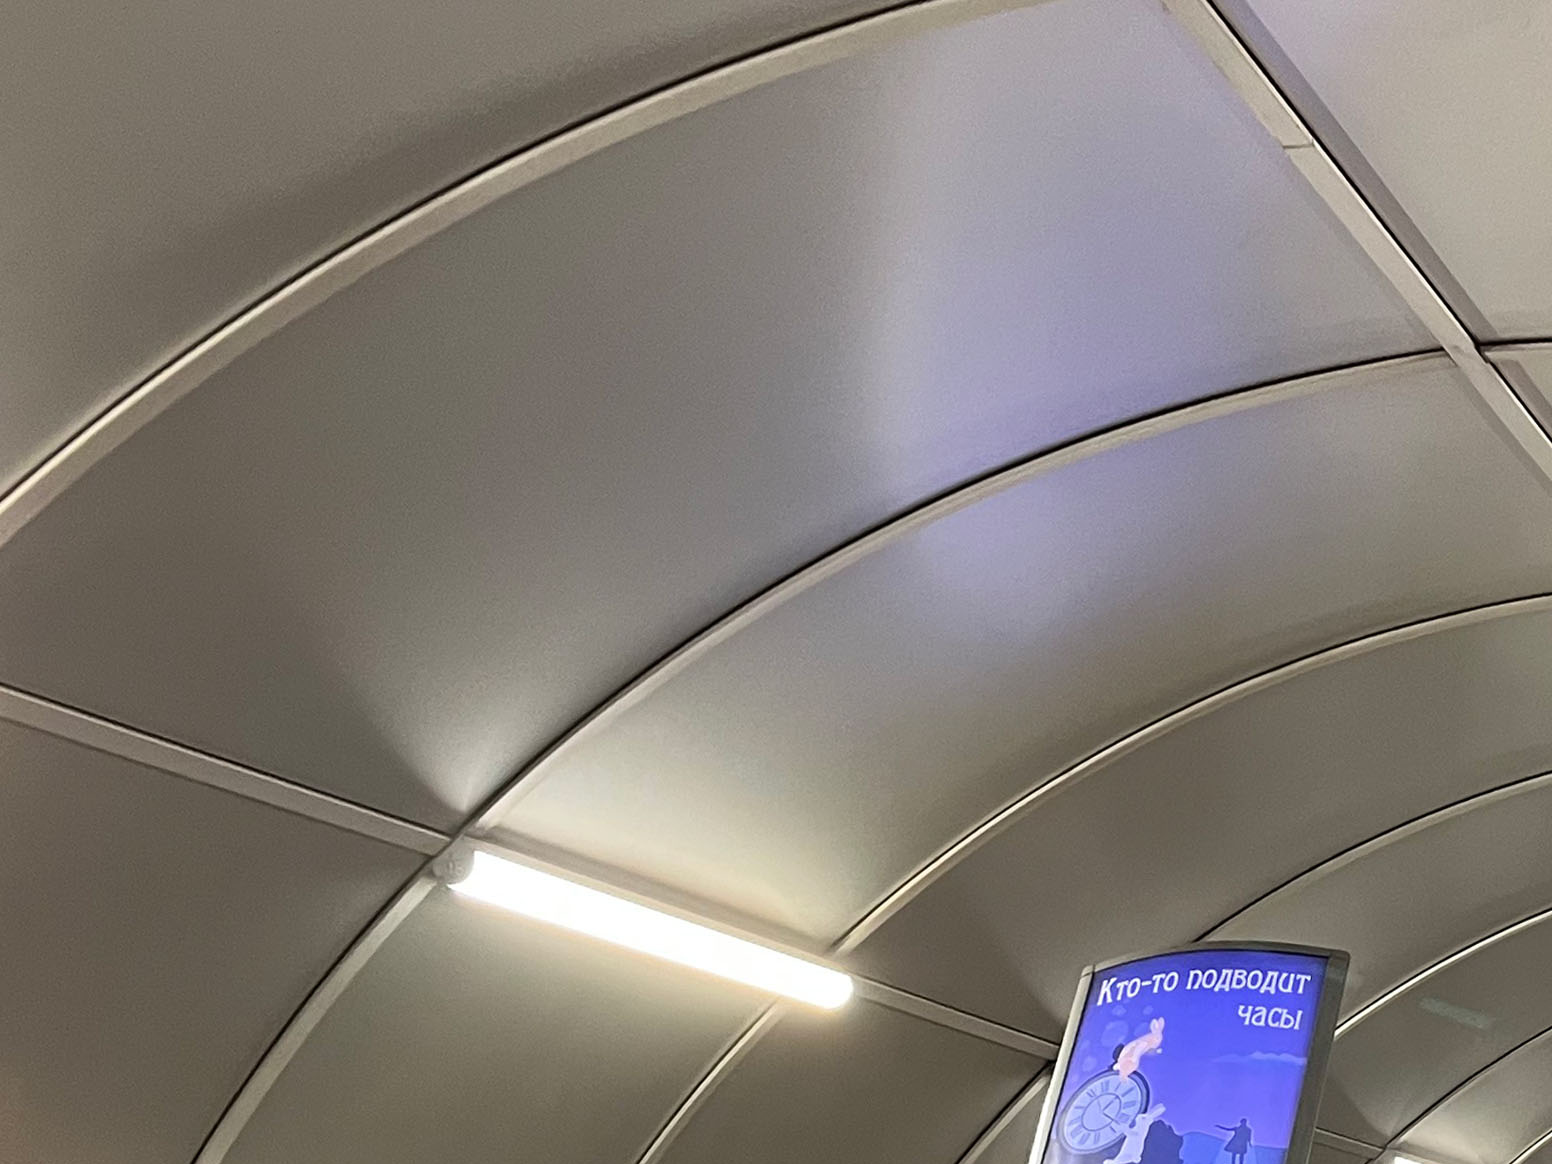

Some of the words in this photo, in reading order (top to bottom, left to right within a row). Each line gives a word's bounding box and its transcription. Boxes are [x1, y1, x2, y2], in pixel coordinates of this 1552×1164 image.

[1096, 971, 1179, 1006] Кто-то
[1185, 968, 1312, 995] подводит
[1237, 1004, 1304, 1031] часы
